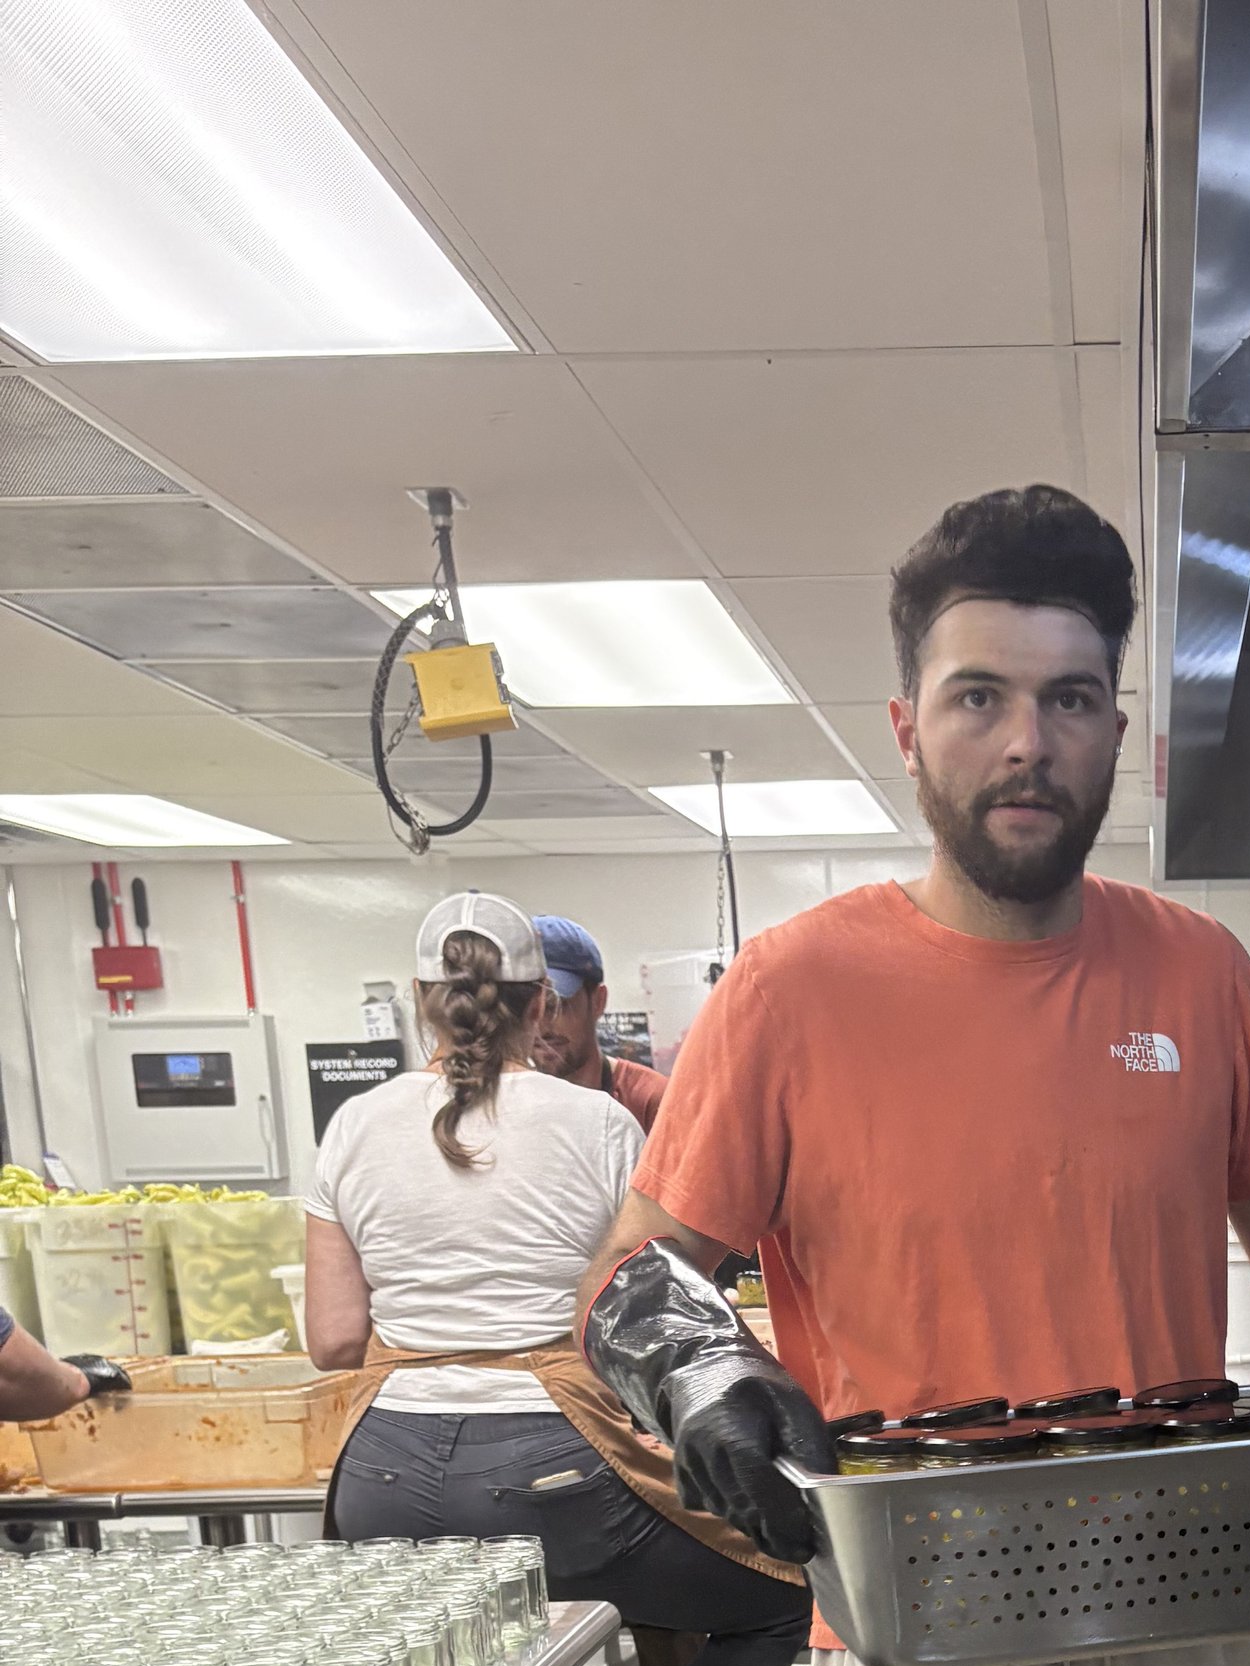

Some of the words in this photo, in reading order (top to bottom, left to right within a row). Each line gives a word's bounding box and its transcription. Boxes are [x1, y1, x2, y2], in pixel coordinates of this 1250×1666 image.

[1129, 1032, 1152, 1046] THE
[1110, 1044, 1155, 1058] NORTH
[311, 1059, 352, 1070] SYSTEM
[354, 1058, 397, 1069] RECORD
[1126, 1058, 1158, 1072] FACE
[322, 1070, 387, 1081] DOCUMENTS
